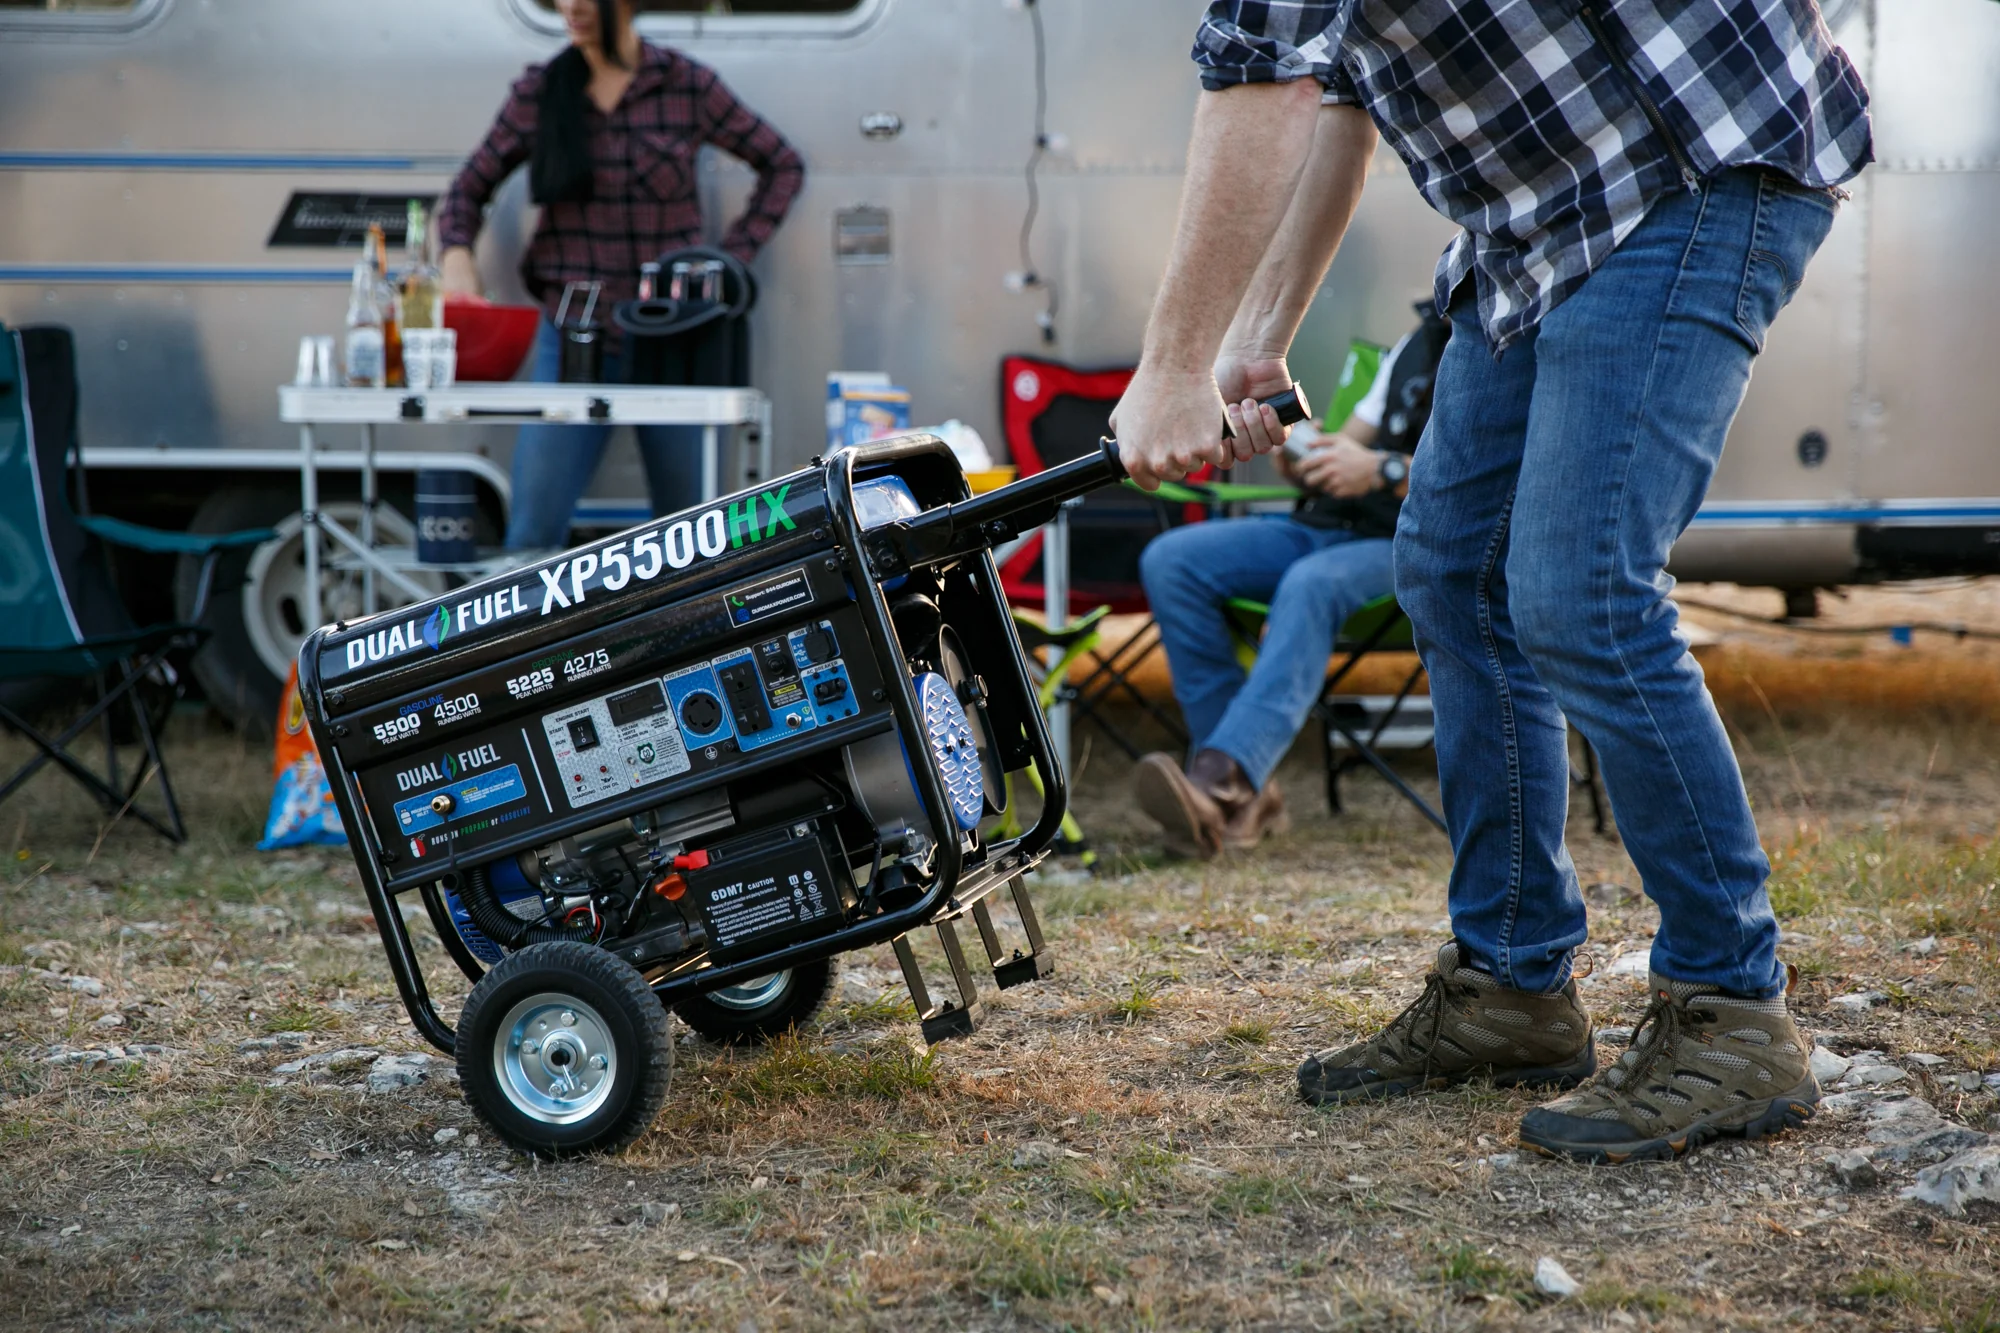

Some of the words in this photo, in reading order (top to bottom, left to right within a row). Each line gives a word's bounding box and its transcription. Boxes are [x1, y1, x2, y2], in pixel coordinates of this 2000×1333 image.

[346, 620, 423, 669] DUAL
[457, 585, 528, 632] FUEL
[538, 484, 797, 615] XP5500HX
[751, 592, 806, 615] DUROMAXPOWER.COM
[532, 649, 576, 670] PROPANE
[716, 655, 729, 663] 120V
[729, 648, 748, 659] OUTLET
[506, 667, 555, 695] 5225
[563, 648, 609, 675] 4275
[567, 670, 593, 682] RUNNING
[593, 662, 612, 674] WATTS
[665, 668, 690, 680] 120/240V
[691, 662, 709, 672] OUTLET
[815, 661, 838, 672] BREAKER
[515, 690, 532, 700] PEAK
[532, 683, 554, 695] WATTS
[399, 694, 445, 716] GASOLINE
[373, 713, 421, 740] 5500
[434, 693, 479, 719] 4500
[437, 714, 463, 726] RUNNING
[463, 706, 482, 719] WATTS
[555, 713, 573, 723] ENGINE
[574, 708, 590, 717] START
[382, 735, 399, 746] PEAK
[398, 728, 420, 740] WATTS
[549, 726, 564, 735] START
[621, 723, 638, 732] VOLTAGE
[622, 729, 636, 737] HERTZ
[396, 762, 443, 791] DUAL
[457, 743, 501, 772] FUEL
[572, 789, 596, 800] CHARGING
[431, 835, 448, 845] RUNS
[460, 820, 489, 836] PROPANE
[500, 806, 531, 823] GASOLINE
[711, 882, 743, 901] 6DM7
[747, 877, 775, 890] CAUTION
